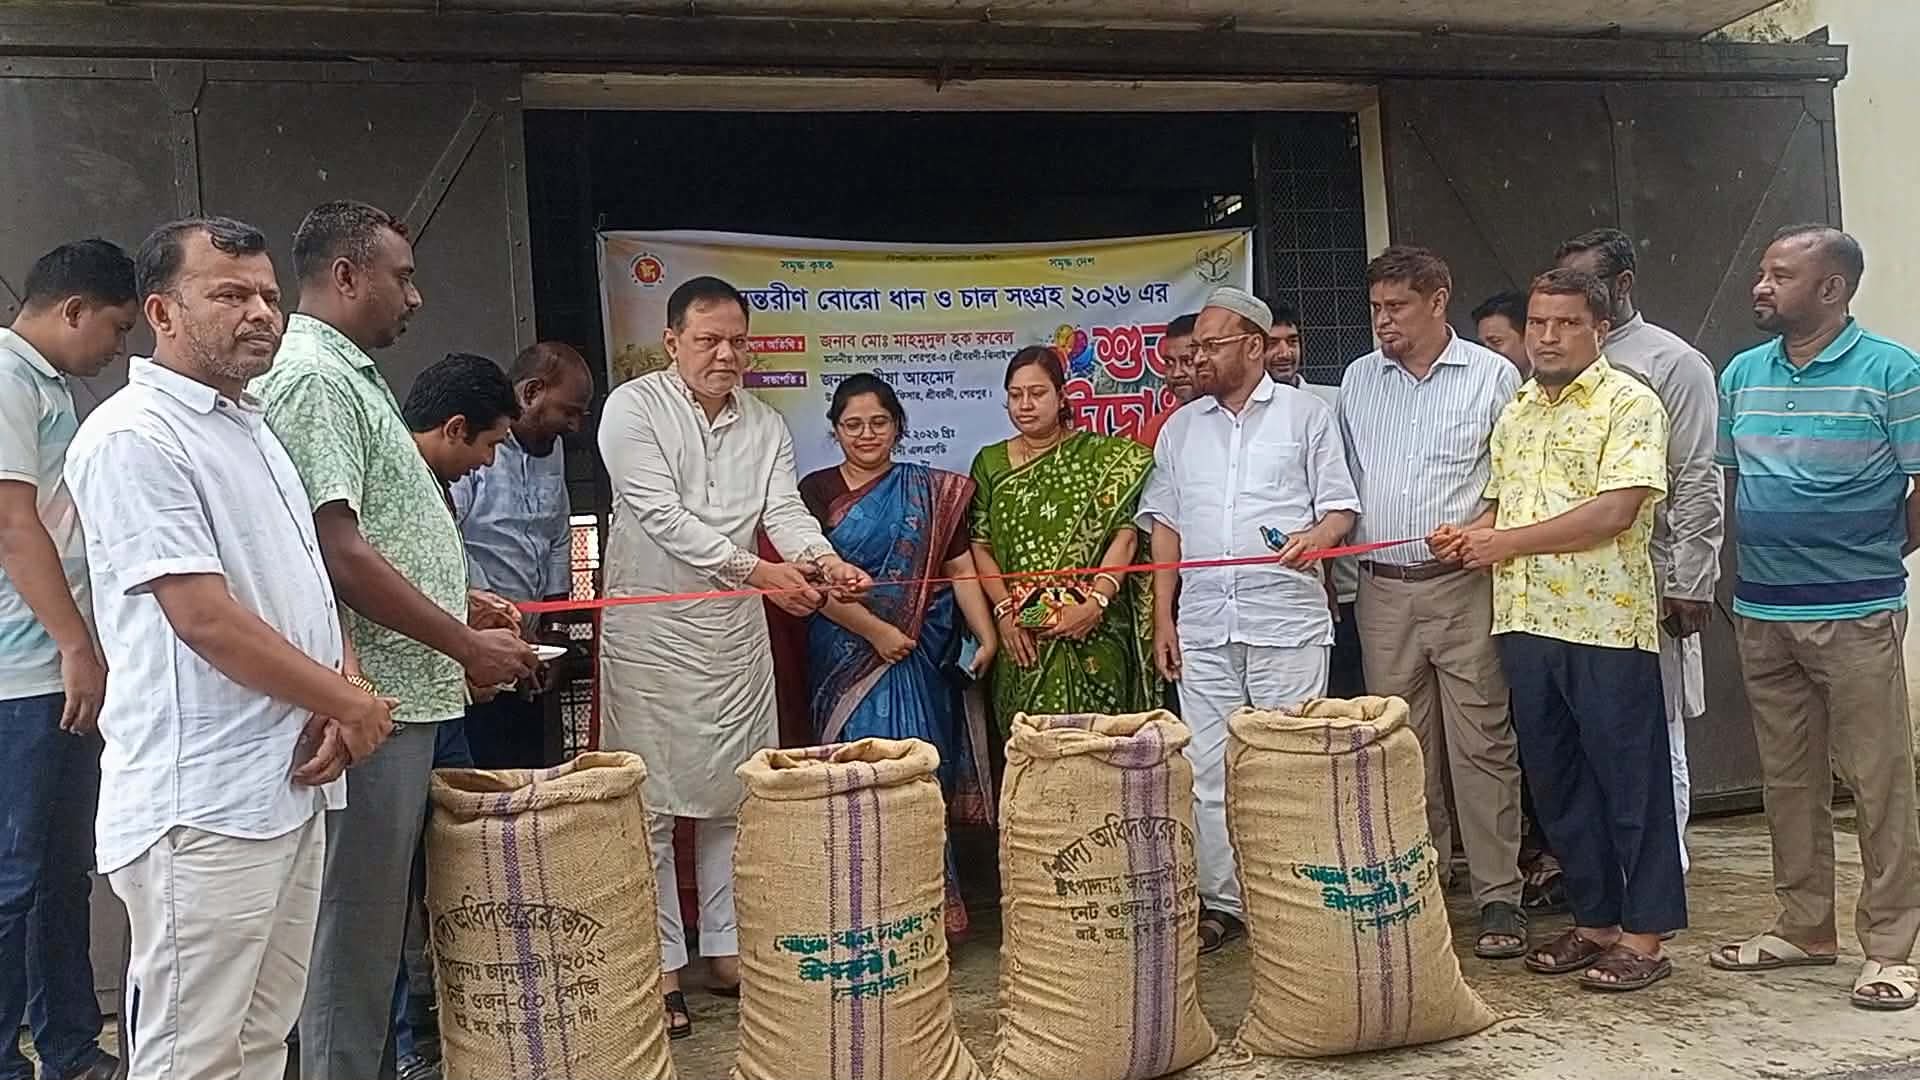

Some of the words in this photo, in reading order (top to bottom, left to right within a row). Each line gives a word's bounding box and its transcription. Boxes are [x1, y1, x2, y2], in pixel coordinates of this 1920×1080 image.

[738, 282, 808, 311] ন্তরীণ
[817, 288, 881, 311] বোরো
[889, 289, 926, 311] ধান
[934, 290, 952, 308] ও
[958, 287, 998, 310] চাল
[1005, 285, 1065, 309] সংগ্রহ
[1071, 286, 1131, 309] ২০২৬
[1139, 282, 1169, 304] এর
[820, 334, 856, 349] জনাব
[861, 334, 888, 348] মোঃ
[893, 333, 947, 350] মাহমুদুল
[951, 332, 972, 347] হক
[976, 331, 1015, 346] রুবেল
[903, 370, 956, 386] আহমেদ
[1070, 901, 1099, 921] নেট
[559, 906, 606, 947] জন্য
